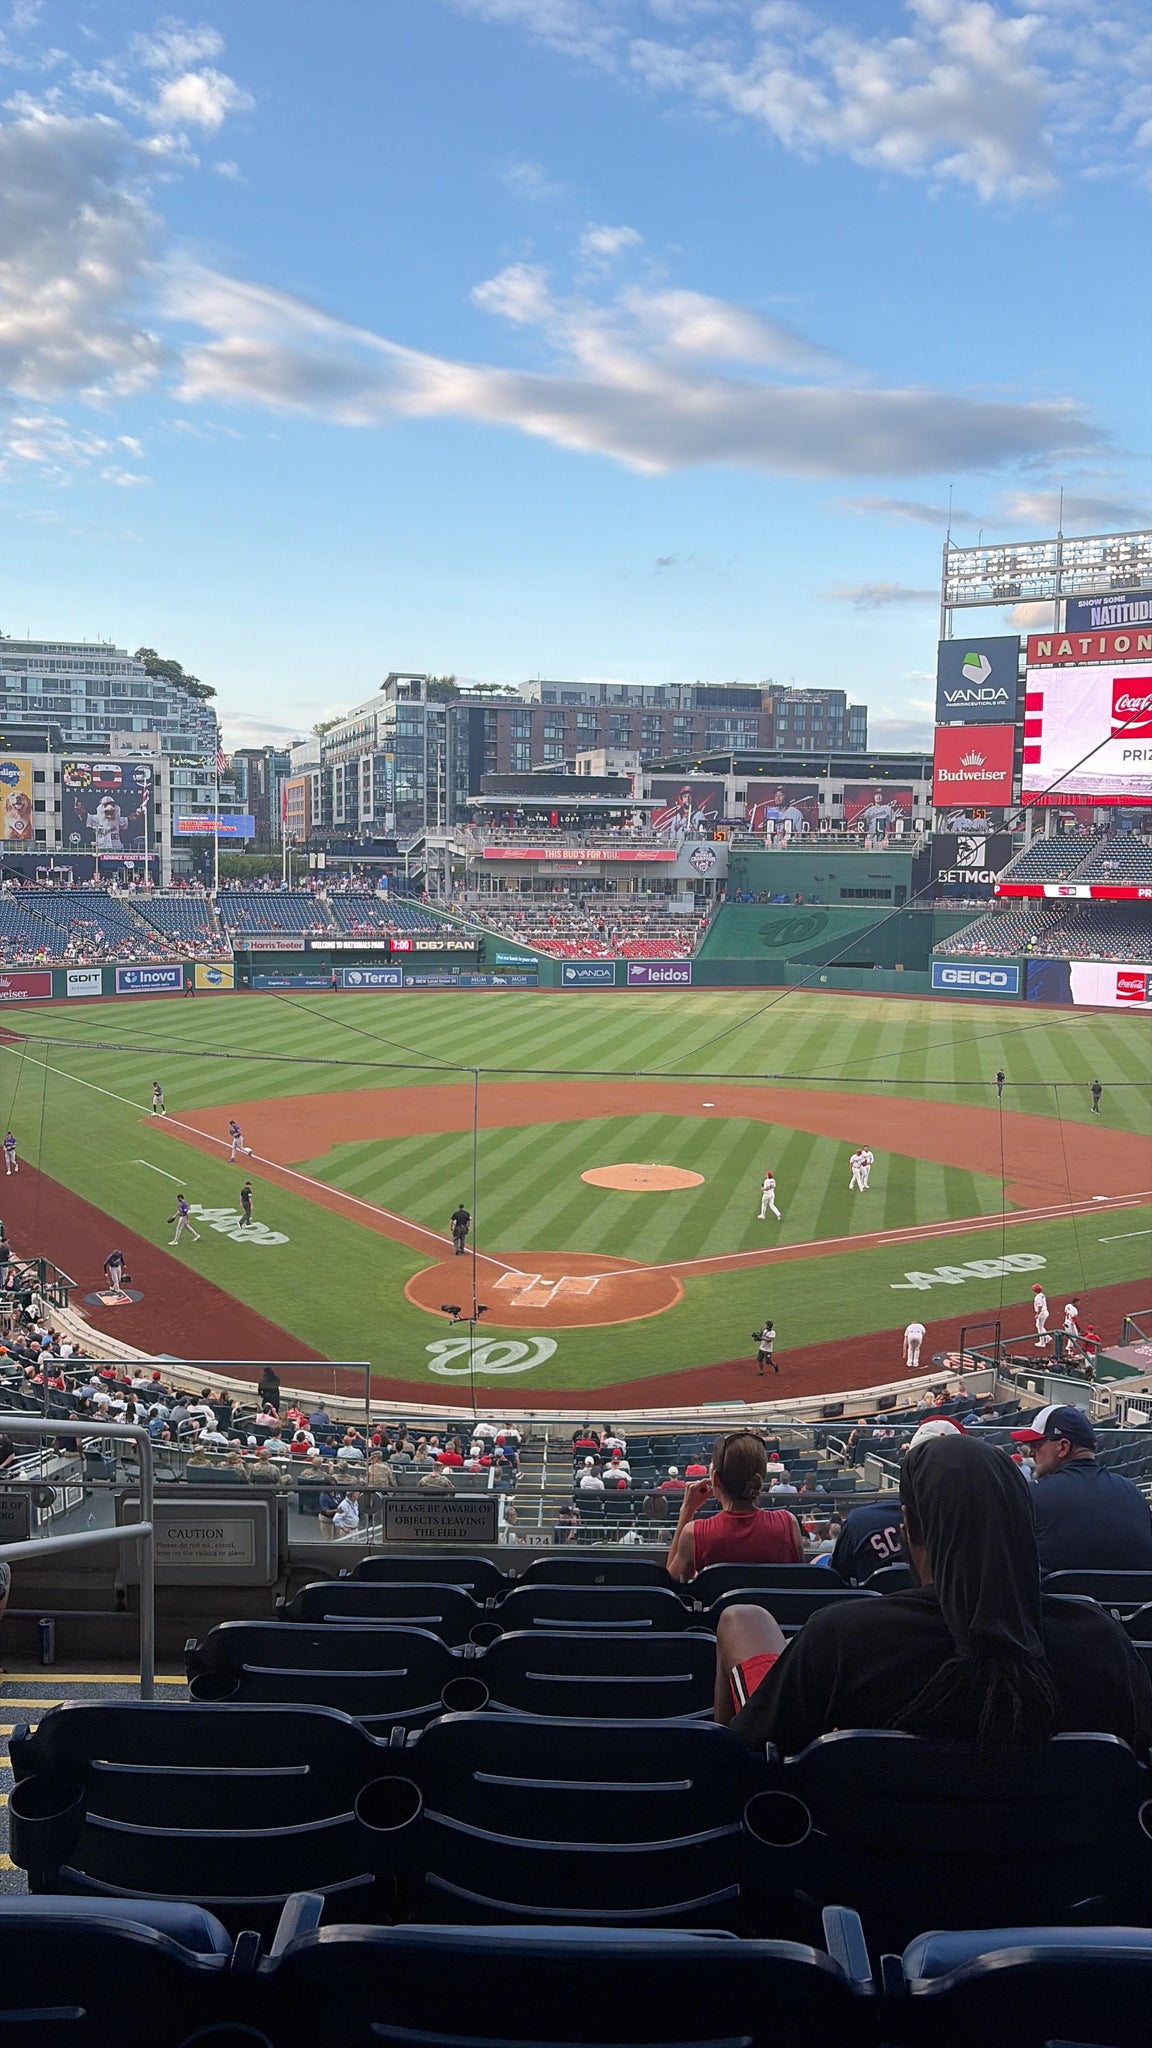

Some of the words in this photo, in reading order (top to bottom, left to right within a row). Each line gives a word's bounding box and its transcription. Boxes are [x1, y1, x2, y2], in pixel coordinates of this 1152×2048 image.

[1078, 598, 1102, 608] SHOW
[1103, 595, 1126, 604] SOME
[1037, 634, 1152, 658] NATION
[944, 688, 1009, 702] VANDA
[938, 768, 1007, 783] Budweiser
[544, 850, 562, 858] THIS
[563, 850, 585, 858] BUD'S
[587, 850, 600, 859] FOR
[394, 941, 409, 950] 7:00
[69, 974, 100, 982] GDIT
[140, 971, 175, 982] Inova
[363, 972, 398, 983] Terra
[648, 968, 688, 981] leidos
[942, 969, 1008, 986] GEICO
[890, 1254, 1048, 1290] AARP
[389, 1504, 424, 1513] PLEASE
[427, 1504, 439, 1513] BE
[442, 1504, 474, 1513] AWARE
[478, 1504, 493, 1513] OF
[395, 1516, 439, 1525] OBJECTS
[441, 1516, 485, 1525] LEAVING
[168, 1529, 223, 1538] CAUTION
[414, 1528, 435, 1537] THE
[438, 1528, 467, 1537] FIELD
[870, 1523, 904, 1559] SC
